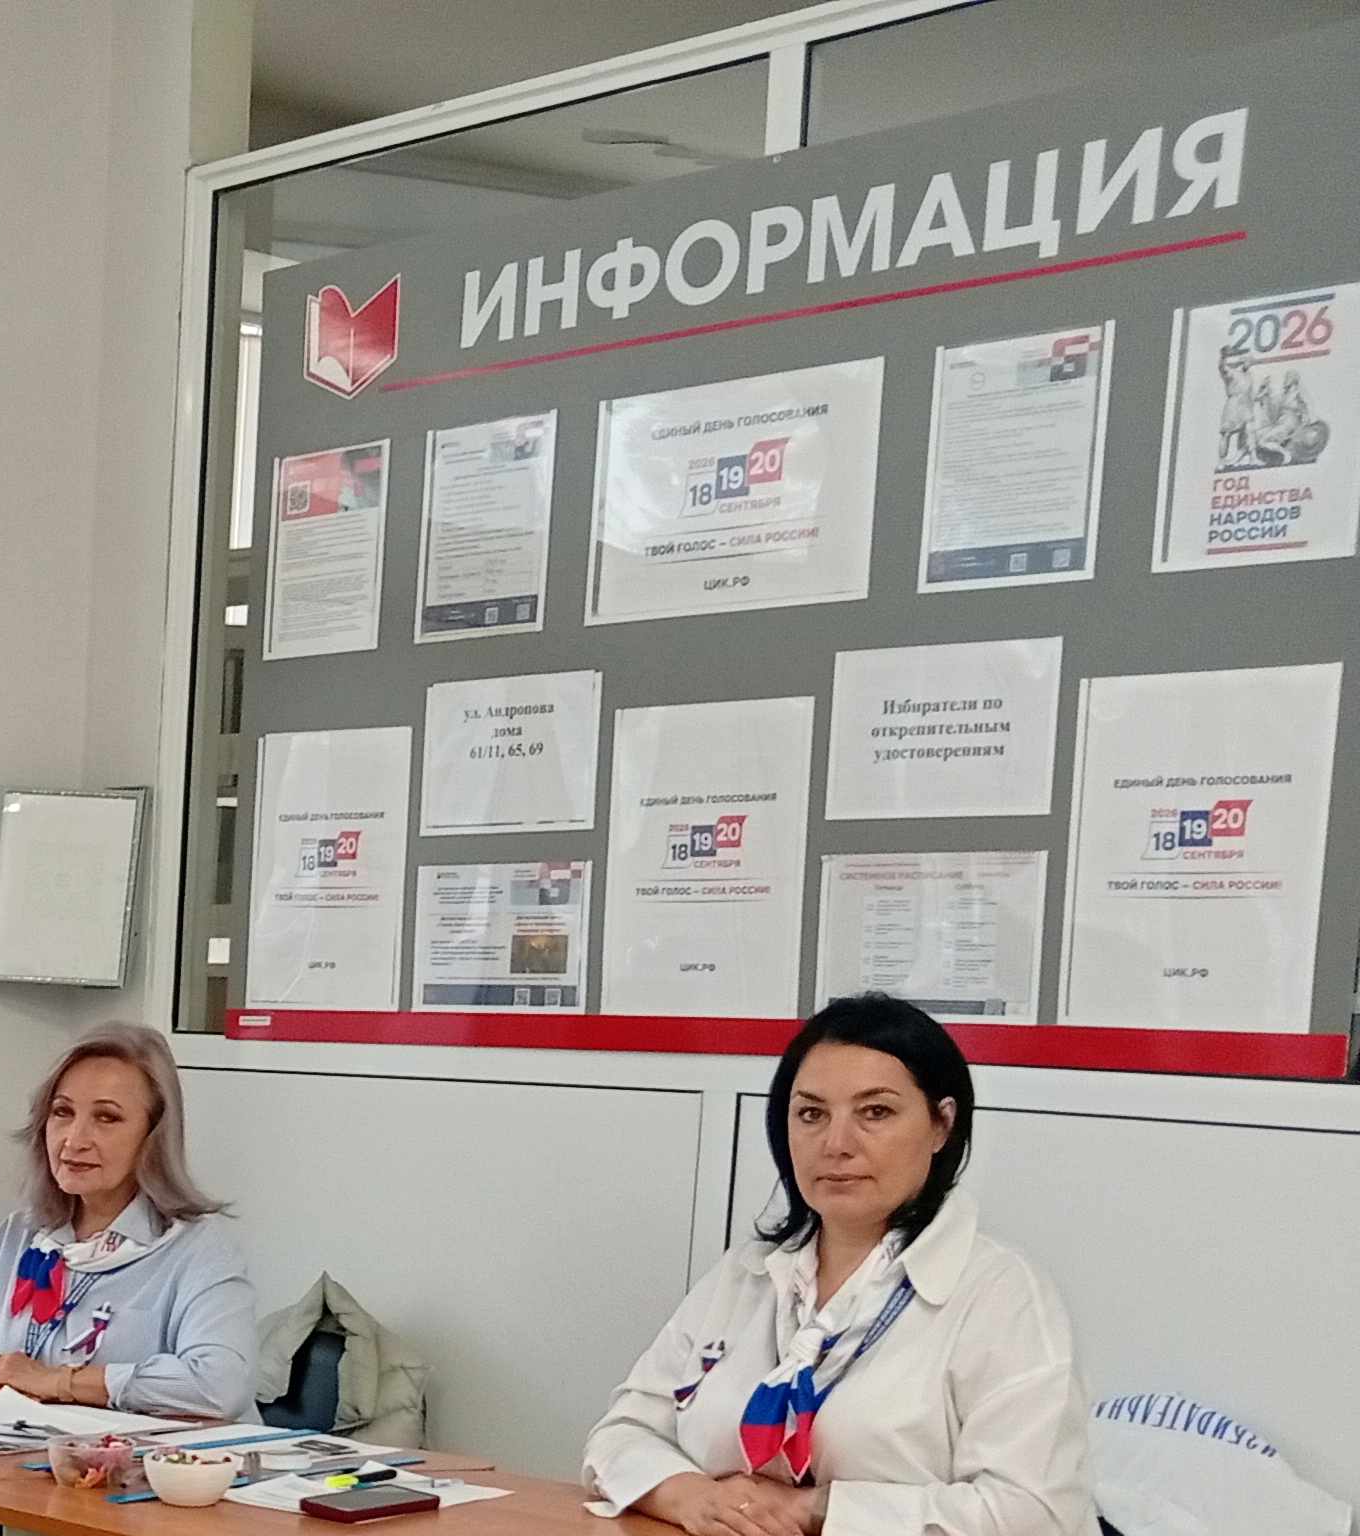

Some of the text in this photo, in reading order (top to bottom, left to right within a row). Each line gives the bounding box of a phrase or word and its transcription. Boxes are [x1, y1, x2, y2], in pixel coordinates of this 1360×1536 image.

[459, 108, 1249, 347] ИНФОРМАЦИЯ
[1228, 306, 1333, 357] 2026
[651, 404, 828, 440] ЕДИНЫЙ ДЕНЬ ГОЛОСОВАНИЯ
[689, 449, 780, 507] 18 19 20
[1212, 476, 1250, 492] ГОД
[719, 497, 781, 514] СЕНТЯБРЯ
[1211, 487, 1313, 510] ЕДИНСТВА
[1209, 505, 1301, 526] НАРОДОВ
[1208, 525, 1288, 543] РОССИИ
[644, 542, 674, 558] ТВОЙ
[677, 540, 715, 554] ГОЛОС
[729, 534, 761, 548] СИЛА
[704, 576, 750, 590] ЦИК.РФ
[463, 704, 554, 723] ул. Андропова
[882, 698, 1003, 716] Избиратели по
[491, 726, 522, 738] дома
[871, 721, 1010, 740] открепительным
[470, 742, 544, 759] 61/11, 65, 69
[873, 744, 1005, 764] удостоверениям
[1114, 774, 1292, 789] ЕДИНЫЙ ДЕНЬ ГОЛОСОВАНИЯ
[680, 796, 704, 806] ДЕНЬ
[706, 793, 777, 804] ГОЛОСОВАНИЯ
[1153, 808, 1243, 851] 18 19 20
[671, 823, 740, 861] 18 19 20
[301, 837, 356, 871] 18 19 20
[1182, 850, 1244, 860] СЕНТЯБРЯ
[636, 886, 659, 896] ТВОЙ
[662, 887, 691, 895] ГОЛОС
[702, 887, 726, 895] СИЛА
[1108, 878, 1282, 890] ТВОЙ ГОЛОС СИЛА РОССИИ!
[1163, 968, 1208, 978] ЦИК.РФ
